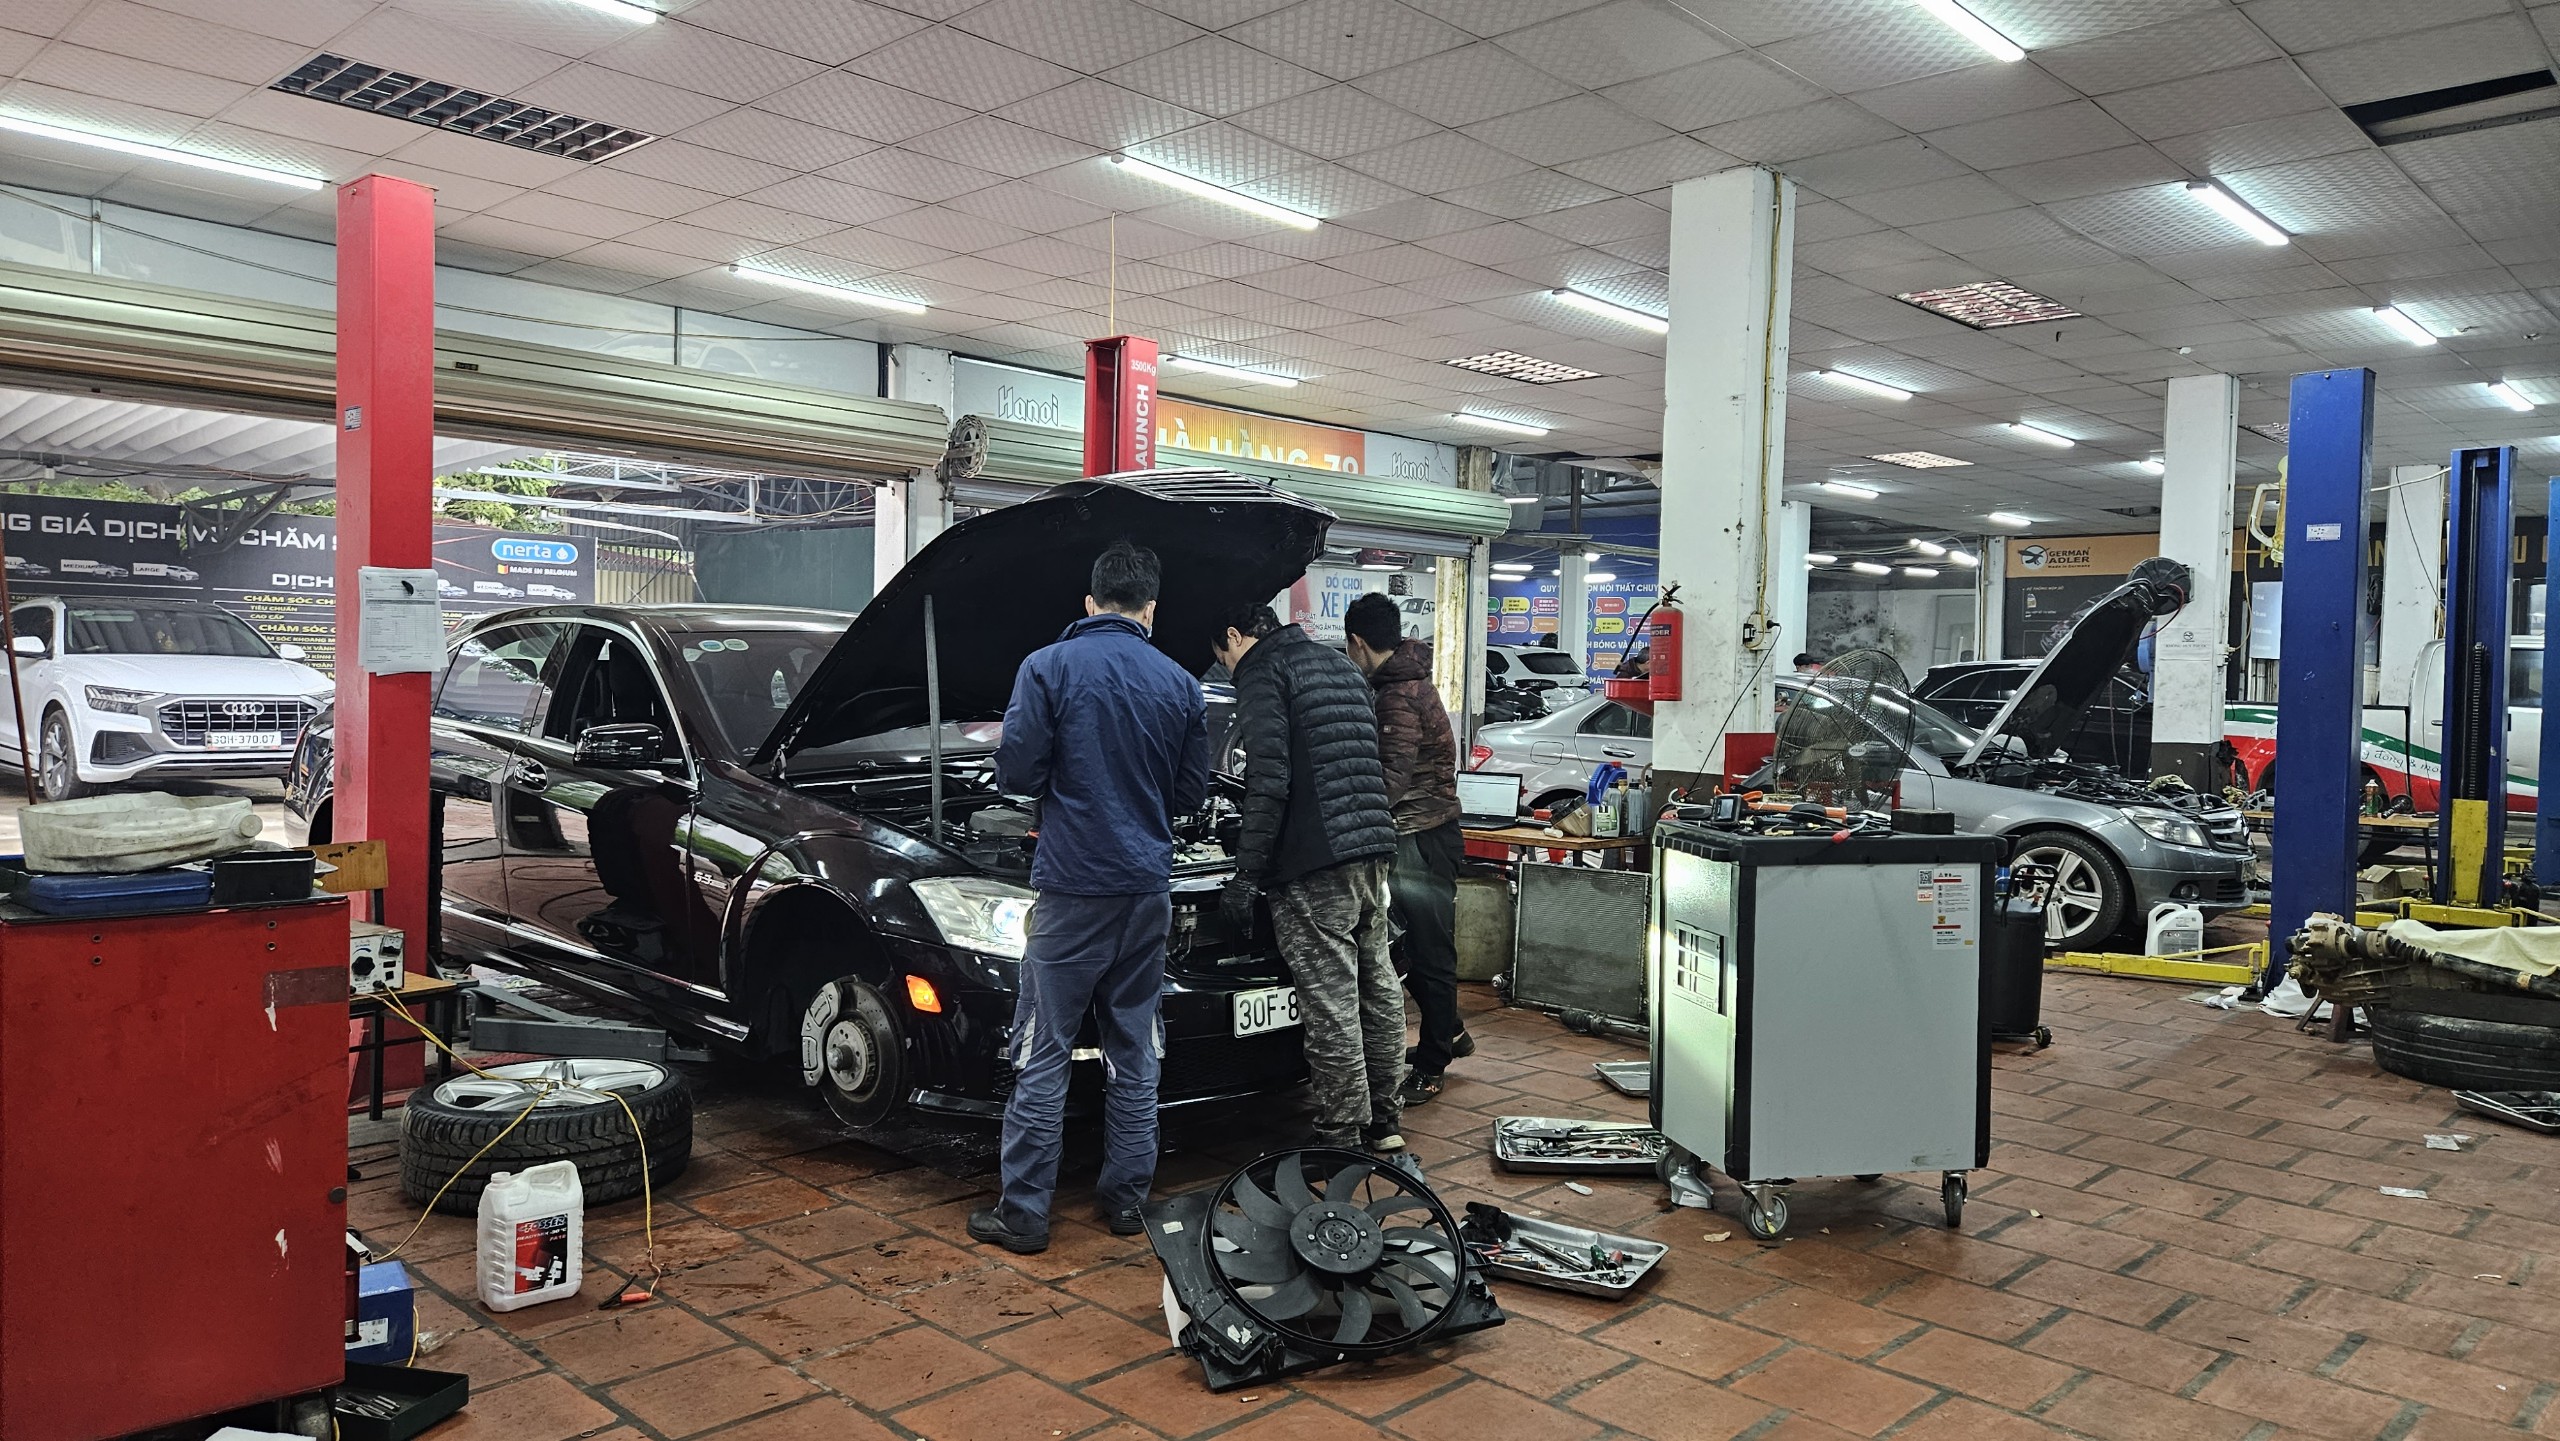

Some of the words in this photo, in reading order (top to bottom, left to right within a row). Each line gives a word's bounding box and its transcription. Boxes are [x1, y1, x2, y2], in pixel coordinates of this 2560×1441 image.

[1131, 360, 1156, 376] 3500Kg
[998, 385, 1059, 427] Hanoi
[1135, 384, 1149, 470] AUNCH
[1391, 452, 1430, 481] Hanoi
[41, 512, 96, 536] GIÁ
[104, 519, 180, 543] DỊCH
[239, 526, 326, 550] CHĂM
[502, 544, 552, 558] nerta
[2049, 549, 2090, 557] GERMAN
[510, 566, 533, 574] MADE
[544, 568, 578, 576] BELGIUM
[272, 573, 334, 589] DỊCH
[1541, 585, 1556, 593] QUY
[1600, 584, 1614, 593] NỘI
[1615, 583, 1636, 592] THẤT
[243, 595, 284, 603] CHĂM
[1321, 592, 1339, 617] XE
[259, 624, 299, 632] CHĂM
[302, 625, 328, 633] SÓC
[1593, 640, 1616, 649] BÓNG
[1239, 990, 1299, 1031] 30F-8
